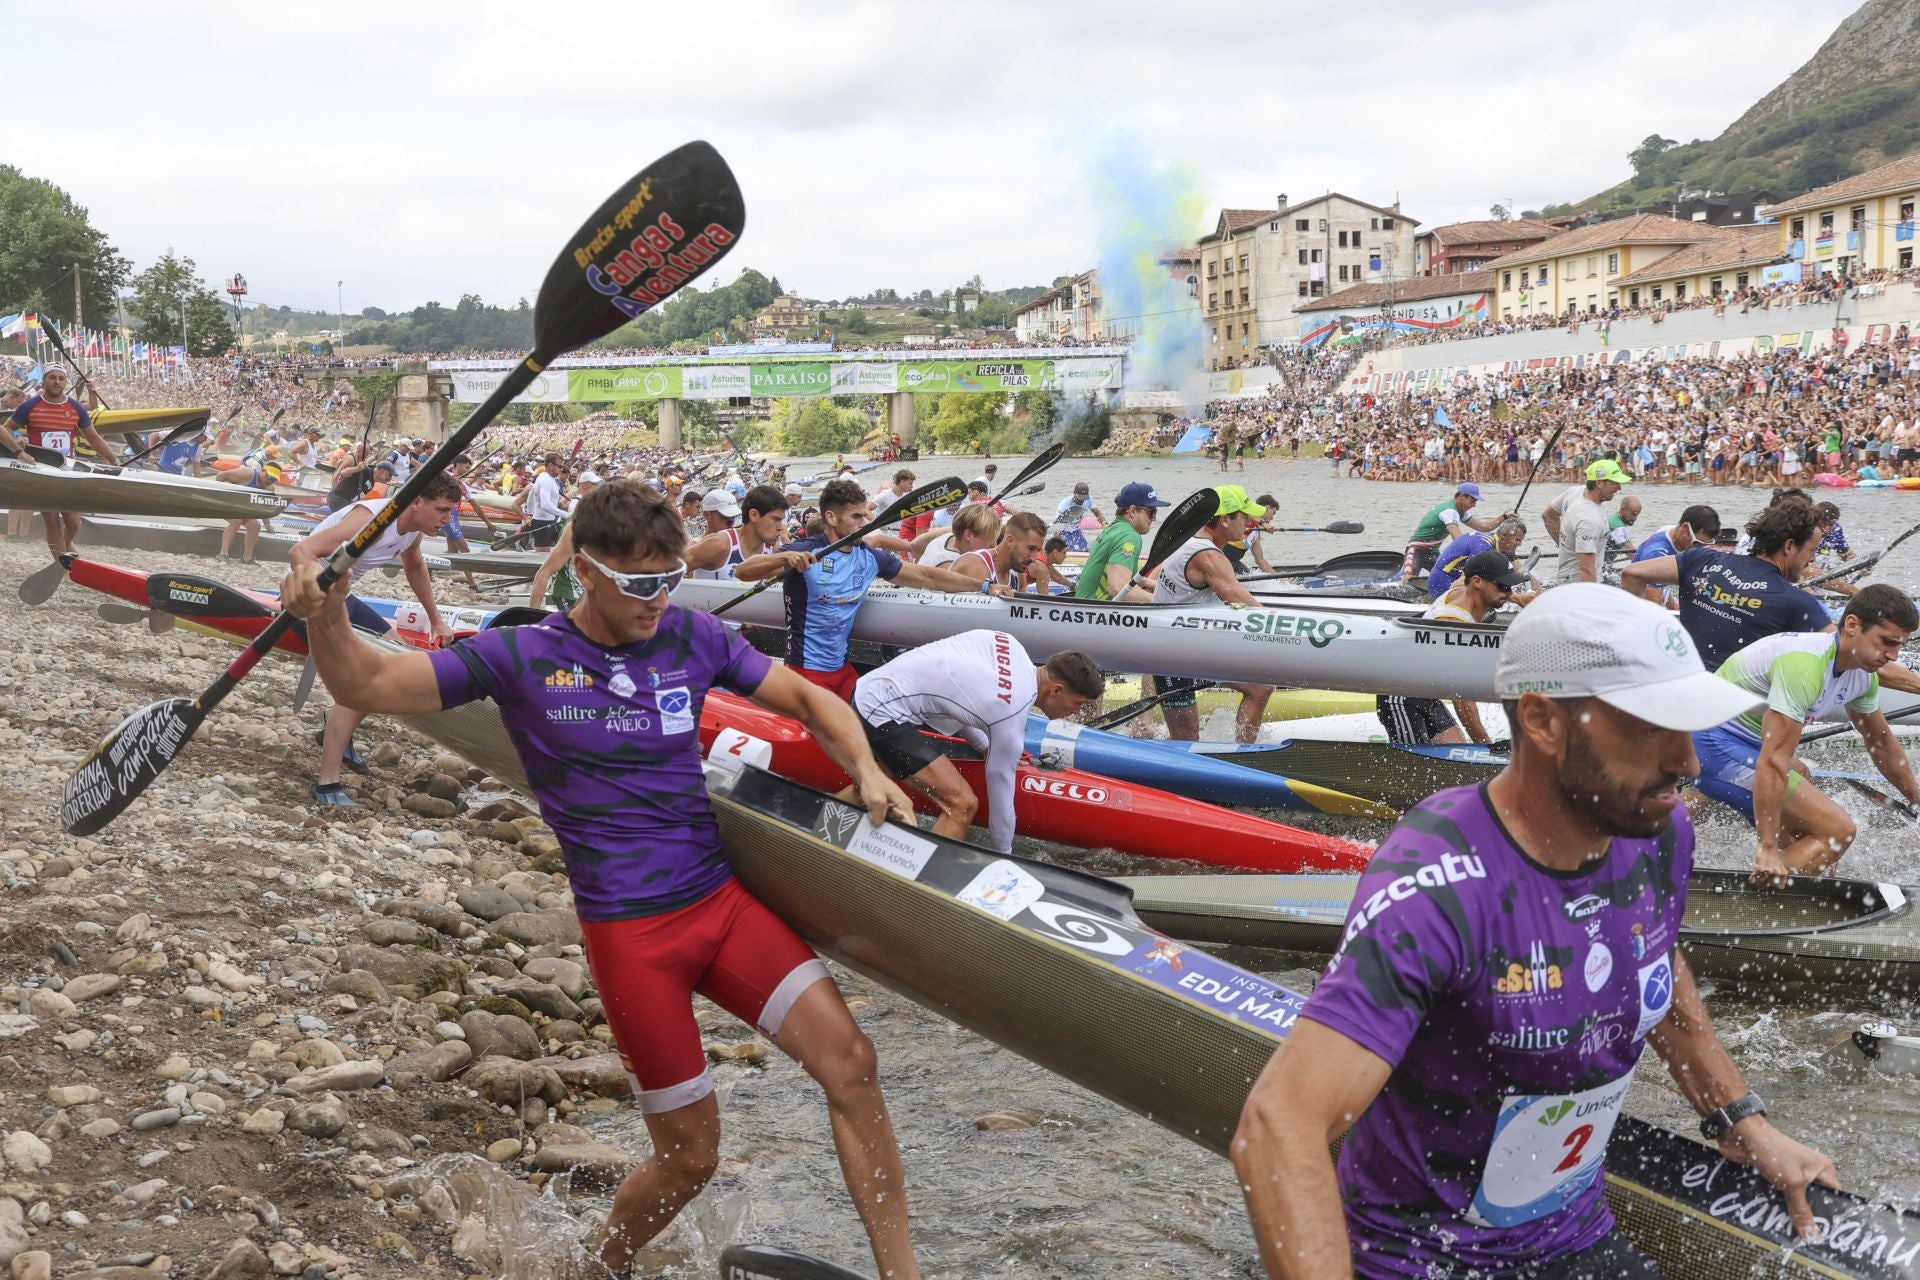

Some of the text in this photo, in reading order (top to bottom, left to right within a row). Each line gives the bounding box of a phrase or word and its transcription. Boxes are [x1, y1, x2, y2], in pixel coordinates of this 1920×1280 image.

[573, 177, 653, 268] Braca-sport
[586, 212, 685, 296] Cangas
[611, 222, 736, 318] Aventura
[711, 373, 746, 383] Asturias
[753, 371, 828, 386] PARAÍSO
[859, 370, 893, 379] Asturias
[978, 365, 1016, 375] RECICLA
[1002, 375, 1028, 386] PILAS
[468, 381, 499, 391] AMBIL
[587, 378, 641, 389] AMBILAMP
[51, 439, 63, 449] 21
[900, 488, 965, 518] ASTOR
[354, 498, 399, 550] Braca-sport
[423, 557, 451, 567] ASTOR
[1159, 568, 1177, 594] STEEL
[1702, 564, 1768, 590] LOS RAPIDOS
[407, 612, 417, 624] 5
[1010, 606, 1149, 629] M.F. CASTAÑON
[1691, 598, 1742, 624] ARRIONDAS
[1171, 615, 1242, 631] ASTOR
[1244, 611, 1345, 648] SIERO
[1242, 634, 1302, 646] AYUNTAMIENTO
[1414, 630, 1505, 649] M. LLAM
[546, 705, 597, 721] salitre
[728, 735, 750, 756] 2
[1448, 748, 1508, 762] FUS
[1024, 777, 1106, 802] NELO
[860, 842, 887, 859] VALERA
[868, 830, 915, 857] FISIOTERAPIA
[1178, 971, 1241, 1003] EDU
[1488, 1026, 1569, 1049] salitre
[1575, 1092, 1625, 1118] Unic
[1552, 1123, 1594, 1174] 2
[1681, 1157, 1727, 1192] el
